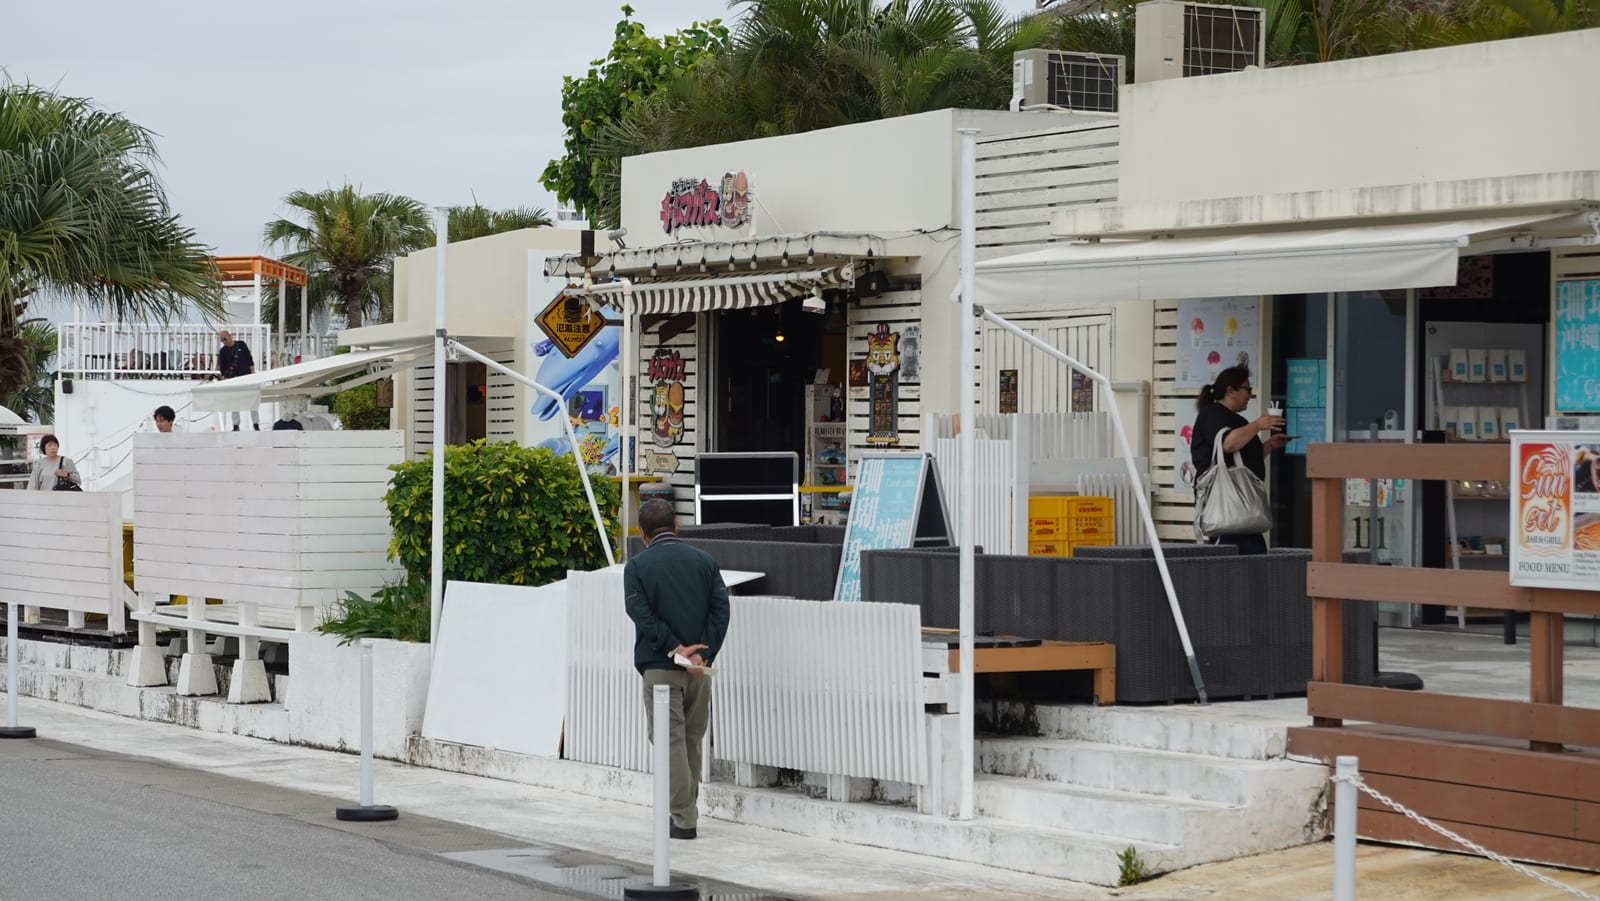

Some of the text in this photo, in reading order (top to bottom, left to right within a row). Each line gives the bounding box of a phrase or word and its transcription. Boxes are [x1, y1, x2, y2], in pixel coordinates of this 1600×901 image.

[1522, 454, 1568, 500] Sun
[1525, 497, 1561, 533] set
[1519, 561, 1543, 572] FOOD
[1545, 563, 1569, 574] MENU
